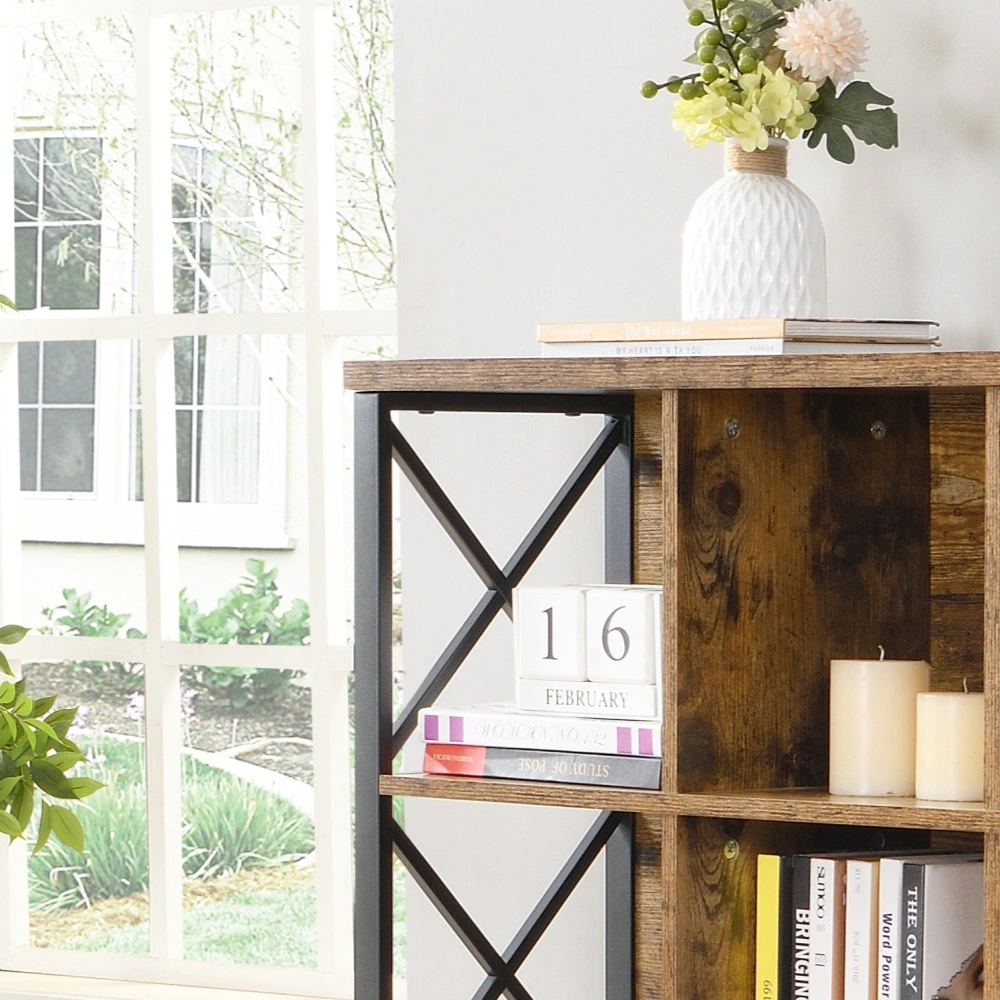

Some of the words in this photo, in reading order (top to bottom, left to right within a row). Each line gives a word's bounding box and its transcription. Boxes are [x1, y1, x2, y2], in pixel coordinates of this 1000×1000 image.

[629, 346, 653, 355] HEART
[686, 346, 702, 354] YOU
[541, 606, 559, 661] 1
[601, 605, 630, 662] 6
[545, 688, 629, 709] FEBRUARY
[518, 758, 545, 772] POSE
[551, 759, 568, 773] OF
[571, 760, 610, 777] STUDY
[907, 886, 918, 928] THE
[882, 912, 893, 949] Word
[882, 955, 893, 999] Power
[906, 934, 918, 993] ONLY
